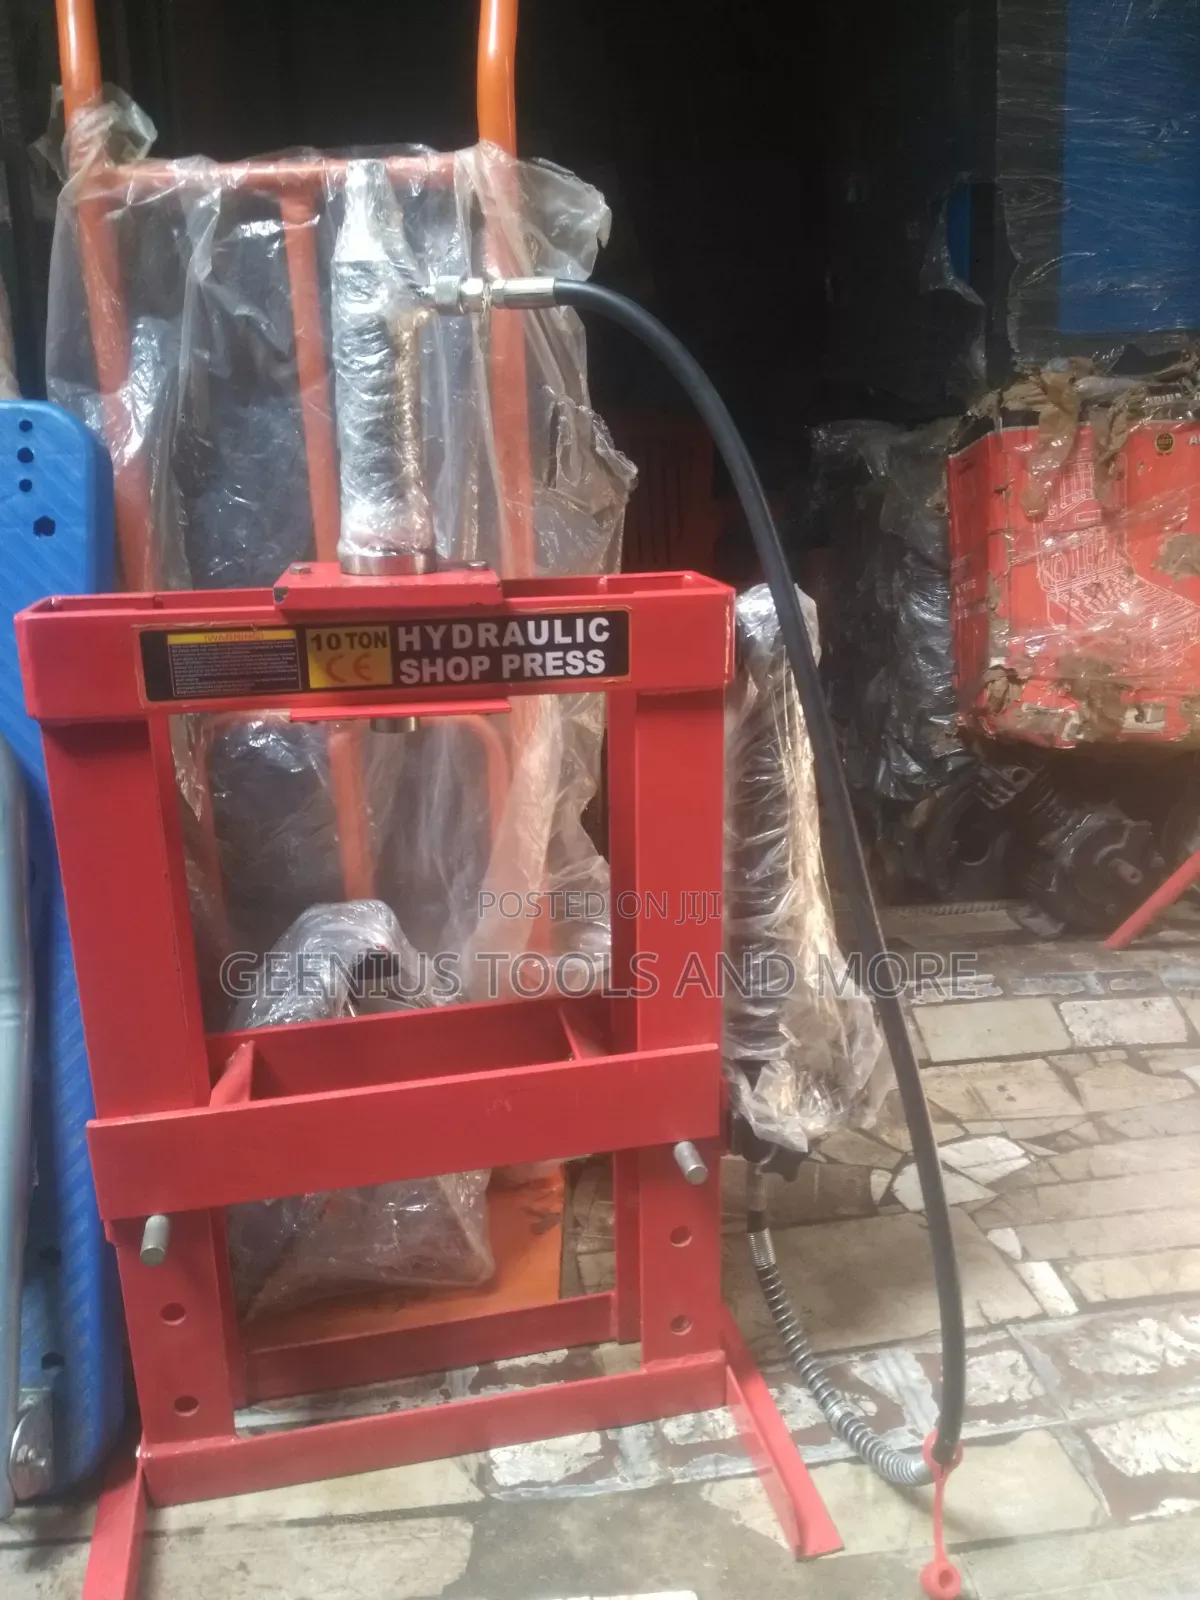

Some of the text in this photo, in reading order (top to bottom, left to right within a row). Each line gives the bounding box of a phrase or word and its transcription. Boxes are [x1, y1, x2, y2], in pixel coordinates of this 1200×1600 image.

[310, 631, 388, 651] 10 TON
[398, 617, 610, 651] HYDRAULIC
[326, 652, 373, 683] CE
[400, 649, 606, 685] SHOP PRESS
